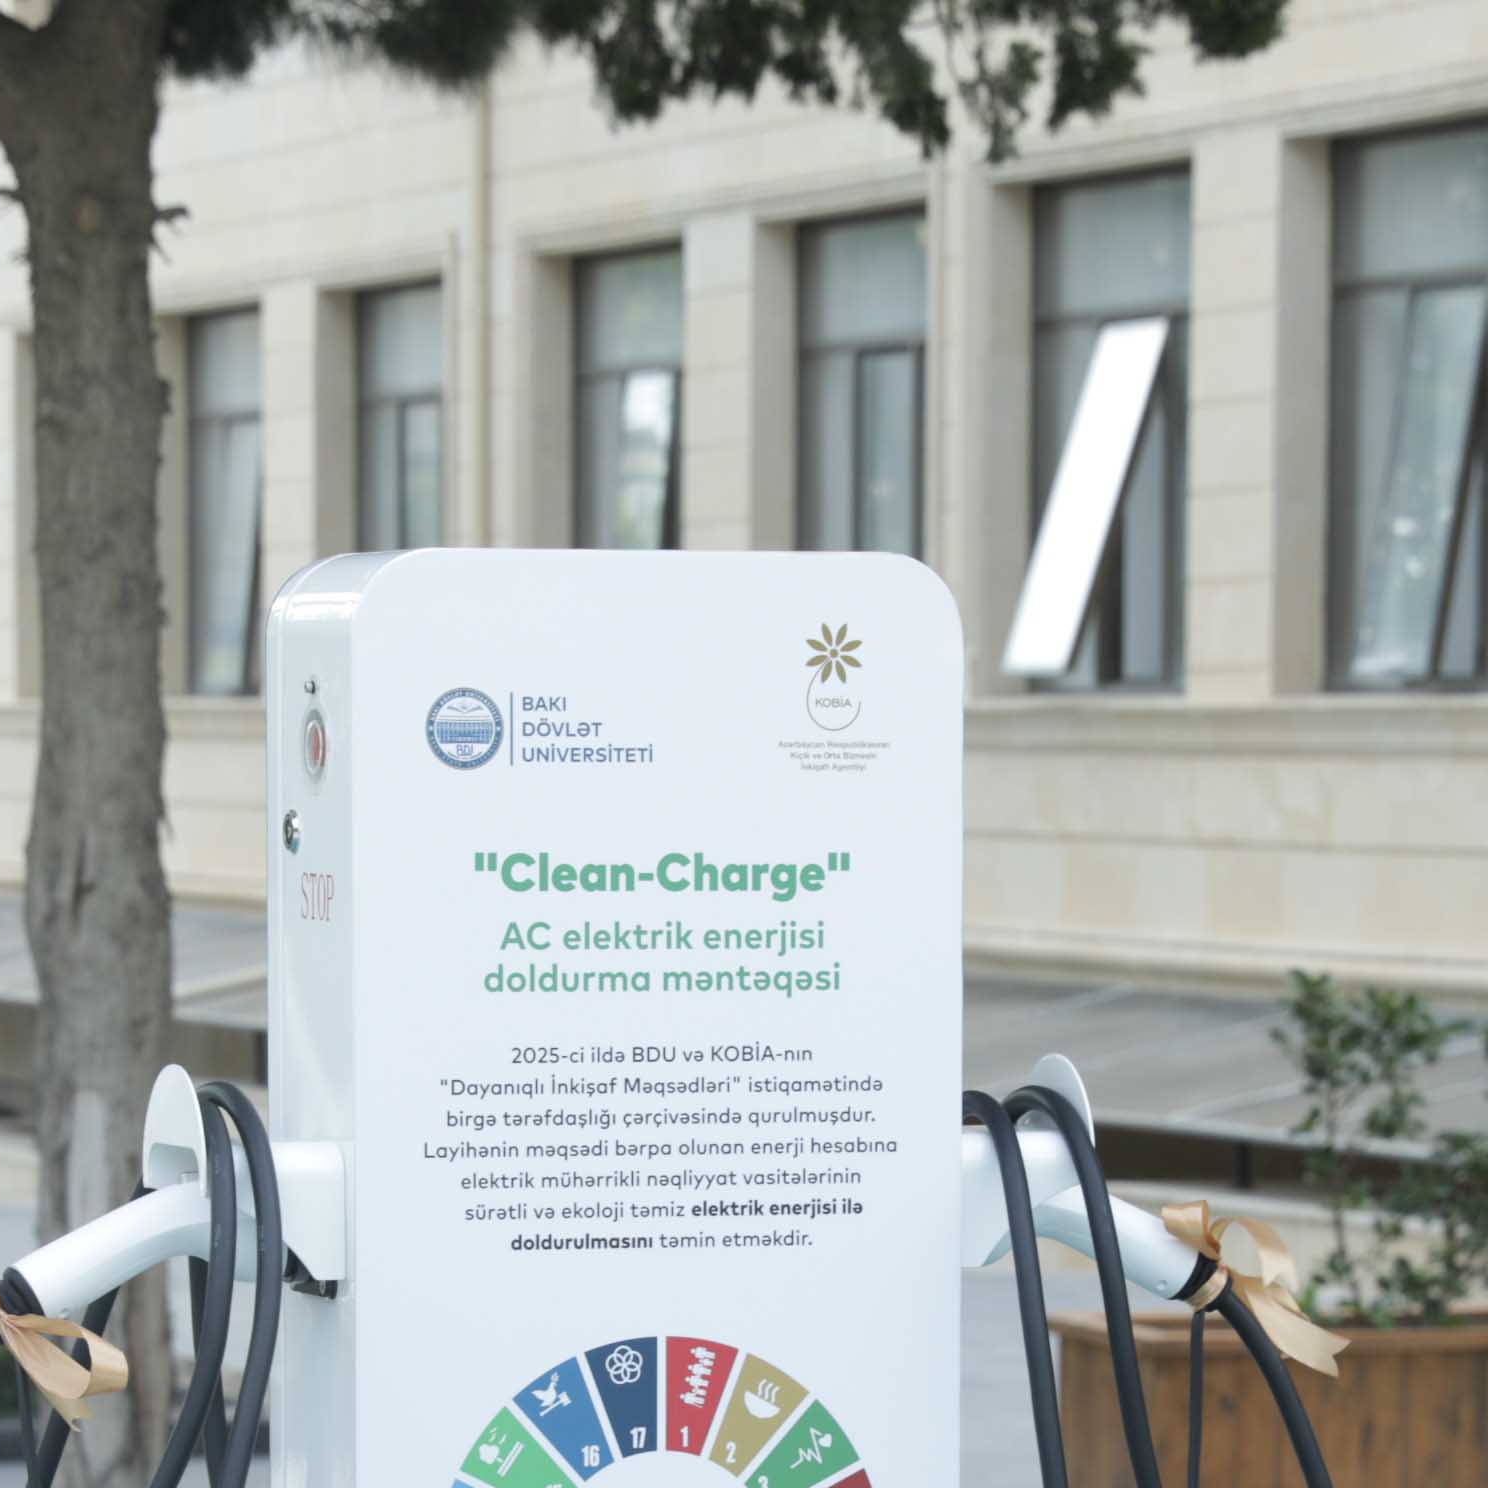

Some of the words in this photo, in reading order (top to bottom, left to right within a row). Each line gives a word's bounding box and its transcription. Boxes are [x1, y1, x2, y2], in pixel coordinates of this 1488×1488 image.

[522, 696, 567, 711] BAKI
[522, 718, 602, 737] DÖVLƏT
[522, 743, 653, 763] UNİVERSİTETİ
[474, 852, 850, 902] "Clean-Charge"
[301, 872, 335, 922] STOP
[500, 922, 551, 950] AC
[563, 921, 693, 950] elektrik
[704, 920, 824, 957] enerjisi
[484, 963, 650, 992] doldurma
[663, 962, 840, 998] məntəqəsi
[512, 1047, 584, 1064] 2025-ci
[591, 1046, 625, 1063] ildə
[632, 1046, 676, 1062] BDU
[683, 1050, 704, 1062] və
[711, 1042, 812, 1062] KOBİA-nın
[440, 1078, 544, 1099] "Dayanıqlı
[552, 1074, 617, 1097] İnkişaf
[624, 1076, 740, 1097] Məqsədləri"
[749, 1075, 883, 1096] istiqamətində
[447, 1110, 496, 1131] birgə
[503, 1109, 616, 1129] tərəfdaşlığı
[623, 1107, 742, 1128] çərçivəsində
[748, 1106, 875, 1127] qurulmuşdur.
[424, 1141, 519, 1161] Layihənin
[526, 1140, 608, 1160] məqsədi
[616, 1140, 671, 1160] bərpa
[679, 1139, 744, 1155] olunan
[751, 1137, 803, 1158] enerji
[811, 1137, 897, 1153] hesabına
[461, 1171, 534, 1189] elektrik
[541, 1170, 640, 1188] mühərrikli
[648, 1170, 737, 1190] nəqliyyat
[743, 1168, 861, 1185] vasitələrinin
[465, 1203, 527, 1220] sürətli
[533, 1208, 555, 1219] və
[561, 1202, 624, 1222] ekoloji
[630, 1201, 685, 1218] təmiz
[691, 1200, 764, 1216] elektrik
[769, 1198, 837, 1219] enerjisi
[842, 1198, 863, 1214] ilə
[511, 1233, 653, 1250] doldurulmasını
[659, 1232, 715, 1248] təmin
[722, 1230, 812, 1247] etməkdir.
[631, 1427, 646, 1448] 17
[681, 1427, 688, 1447] 1
[582, 1445, 599, 1466] 16
[726, 1441, 736, 1463] 2
